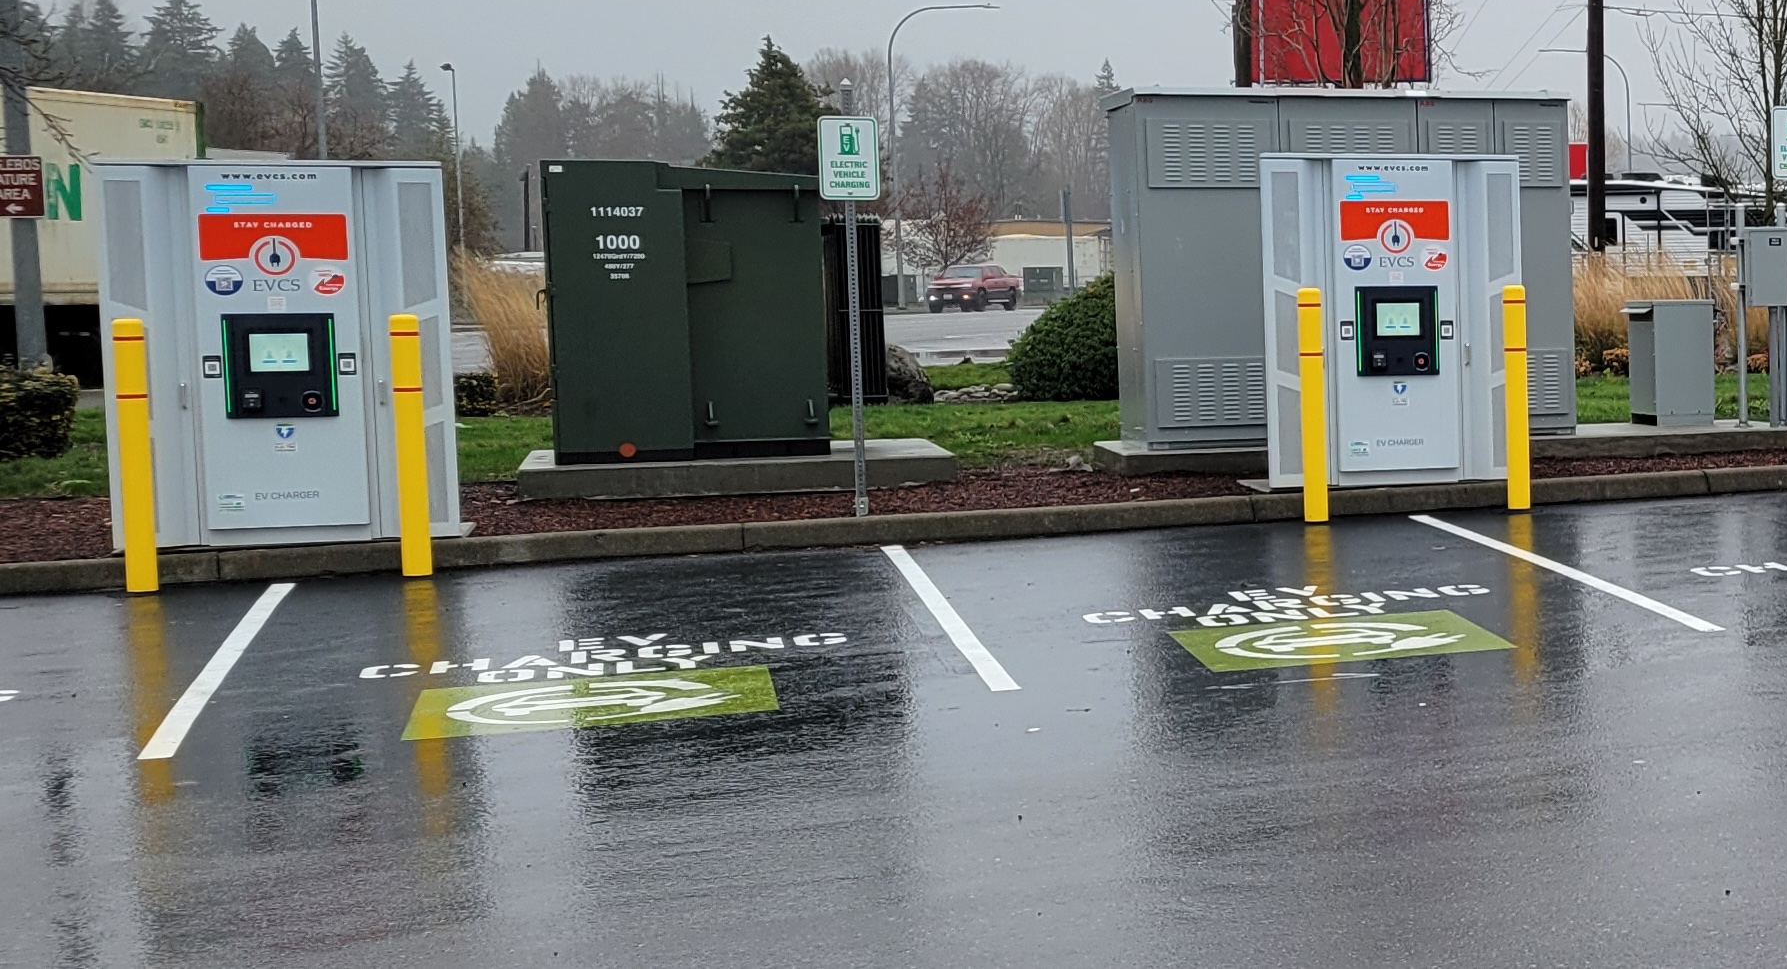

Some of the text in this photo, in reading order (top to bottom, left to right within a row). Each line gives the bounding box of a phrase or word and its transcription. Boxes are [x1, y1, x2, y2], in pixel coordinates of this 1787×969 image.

[0, 159, 40, 170] LEBOS
[830, 160, 868, 168] ELECTRIC
[220, 172, 318, 181] www.evcs.com
[833, 170, 866, 179] VEHICLE
[829, 181, 870, 189] CHARGING
[589, 206, 645, 217] 1114037
[233, 221, 313, 229] STAY CHARGED
[595, 234, 641, 250] 1000
[1379, 256, 1415, 268] EVCS
[252, 279, 301, 292] EVCS
[1376, 438, 1424, 447] EV CHARGER
[255, 490, 320, 501] EV CHARGER
[1228, 585, 1318, 602] EV
[1081, 583, 1491, 625] CHARGING
[1196, 601, 1387, 627] ONLY
[558, 632, 668, 653] EV
[359, 632, 848, 681] CHARGING
[476, 654, 713, 683] ONLY
